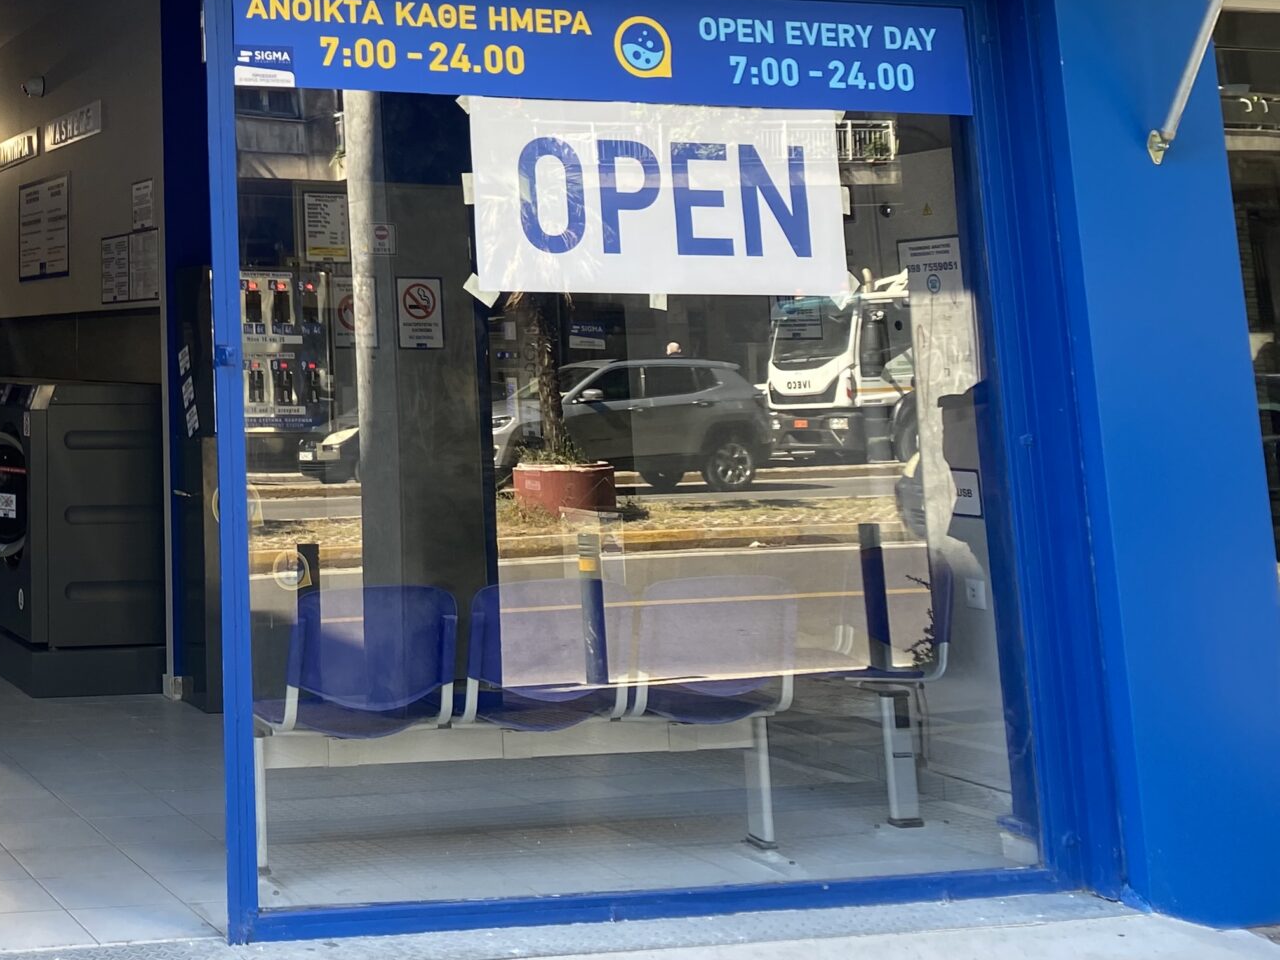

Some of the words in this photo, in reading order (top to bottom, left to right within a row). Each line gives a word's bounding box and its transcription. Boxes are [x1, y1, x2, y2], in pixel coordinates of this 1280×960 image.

[395, 1, 477, 30] ΚΑΘΕ
[489, 6, 592, 36] ΗΜΕΡΑ
[698, 16, 775, 44] OPEN
[785, 20, 873, 48] EVERY
[883, 25, 937, 52] DAY
[254, 50, 291, 62] SIGMA
[320, 36, 397, 70] 7:00
[729, 55, 800, 87] 7:00
[517, 136, 813, 258] OPEN
